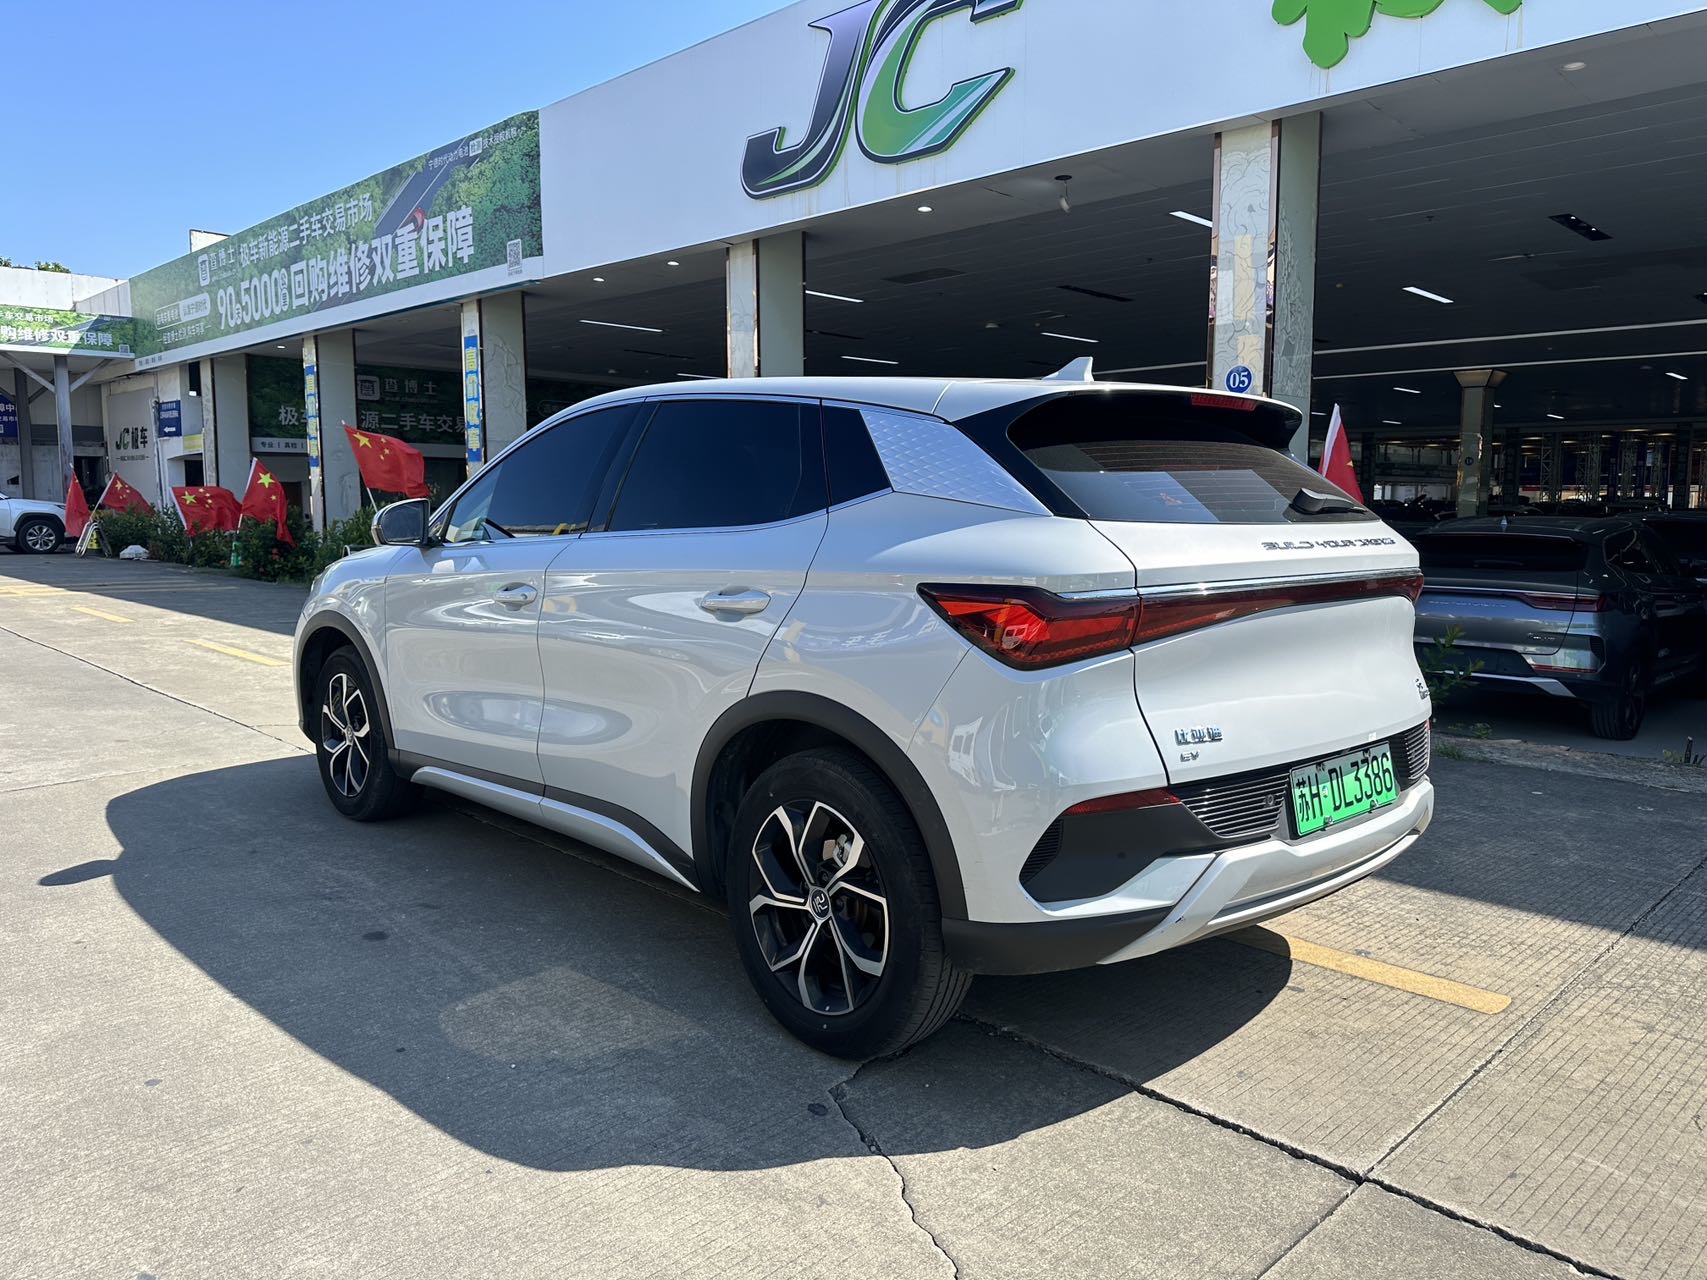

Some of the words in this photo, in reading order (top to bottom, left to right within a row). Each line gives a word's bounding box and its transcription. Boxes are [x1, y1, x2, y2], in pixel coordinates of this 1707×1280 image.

[741, 0, 1023, 199] JC
[1229, 371, 1249, 388] 05
[1180, 751, 1199, 762] EV
